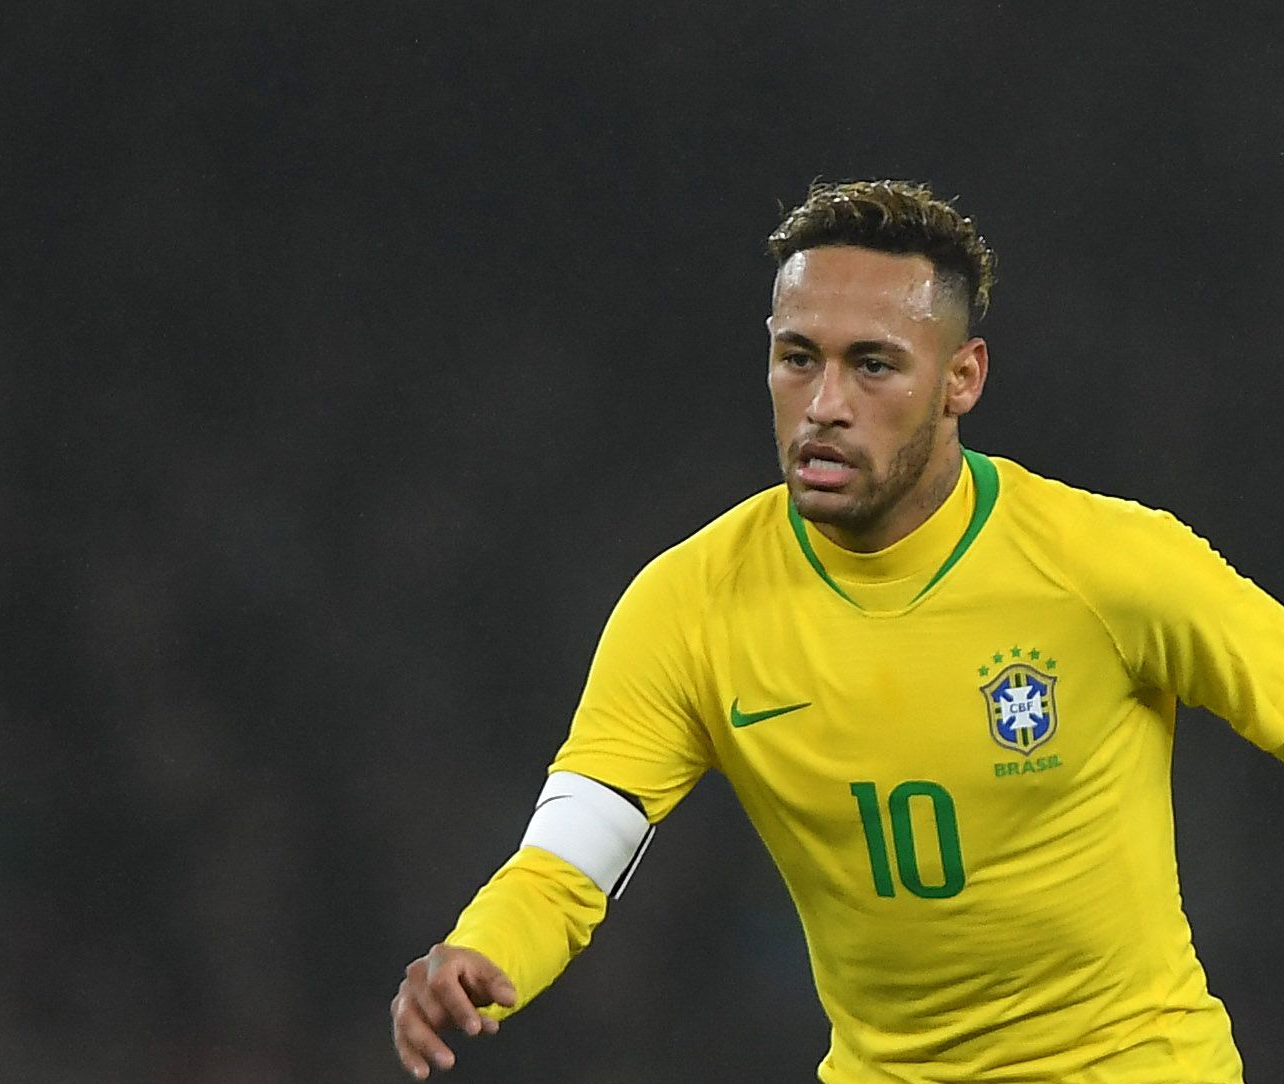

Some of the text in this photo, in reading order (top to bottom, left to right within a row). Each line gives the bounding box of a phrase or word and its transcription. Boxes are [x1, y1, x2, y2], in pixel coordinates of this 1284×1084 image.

[1009, 701, 1034, 714] CBF
[994, 754, 1063, 777] BRASIL
[850, 780, 966, 899] 10
